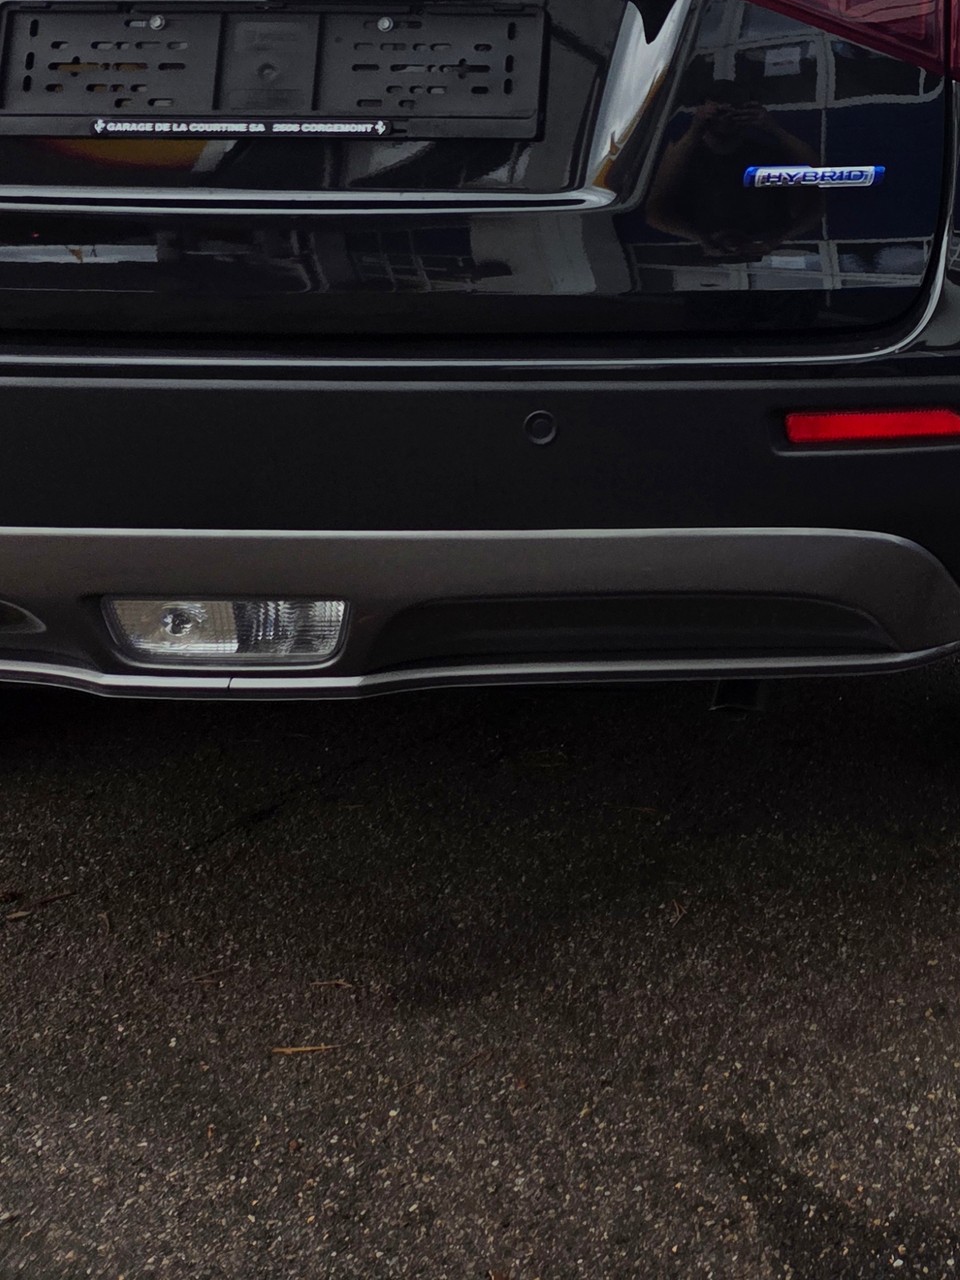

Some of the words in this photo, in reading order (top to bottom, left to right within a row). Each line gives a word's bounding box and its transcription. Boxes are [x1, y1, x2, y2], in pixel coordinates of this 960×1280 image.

[106, 123, 154, 131] GARAGE
[155, 123, 171, 131] DE
[172, 123, 188, 132] LA
[189, 123, 248, 132] COURTINE
[248, 123, 266, 132] SA
[301, 123, 374, 132] CORGEMONT
[765, 170, 867, 185] HYBRID
